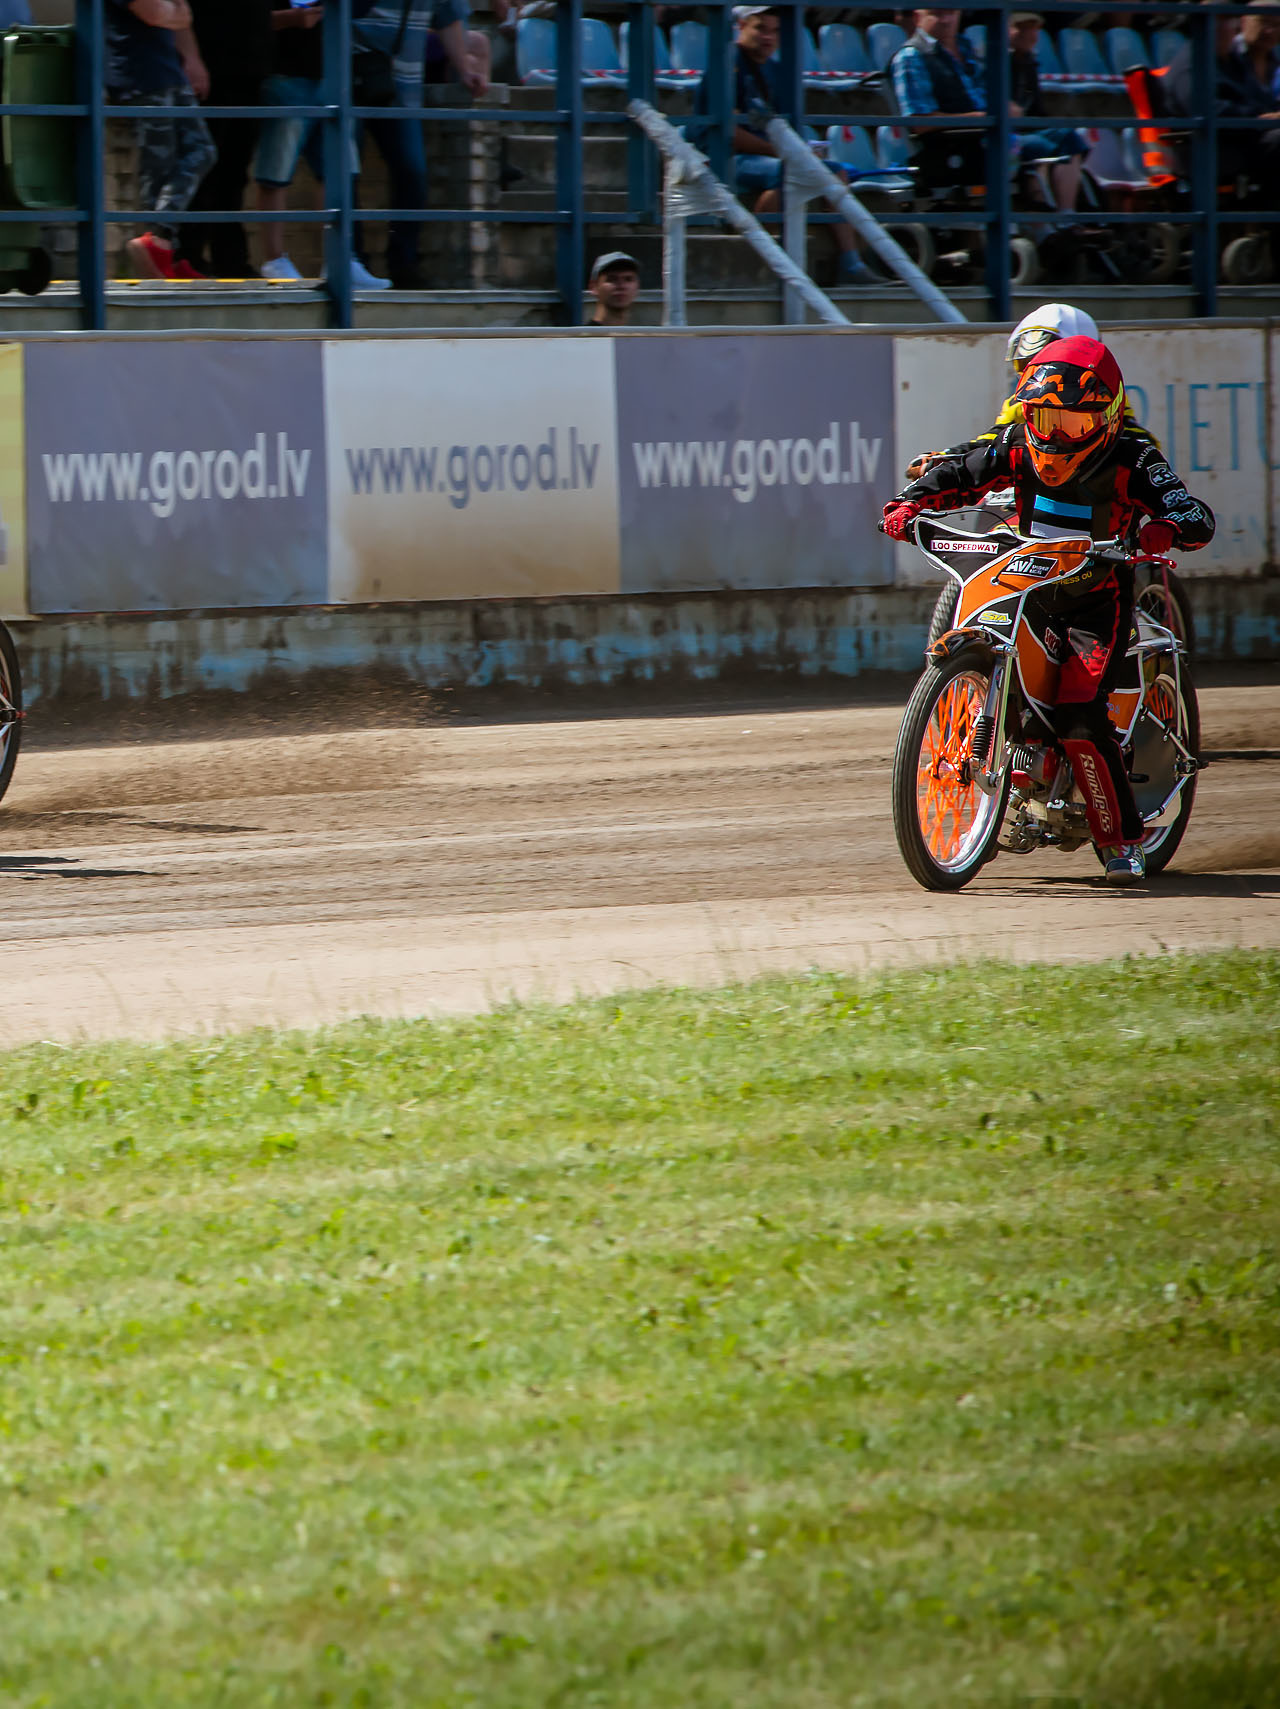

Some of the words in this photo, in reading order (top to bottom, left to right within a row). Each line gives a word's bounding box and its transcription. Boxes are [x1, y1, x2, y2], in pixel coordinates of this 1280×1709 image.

[42, 432, 312, 518] www.gorod.lv
[344, 426, 600, 510] www.gorod.lv
[632, 421, 882, 503] www.gorod.lv
[932, 542, 951, 550] LOO
[952, 543, 998, 553] SPEEDWAY
